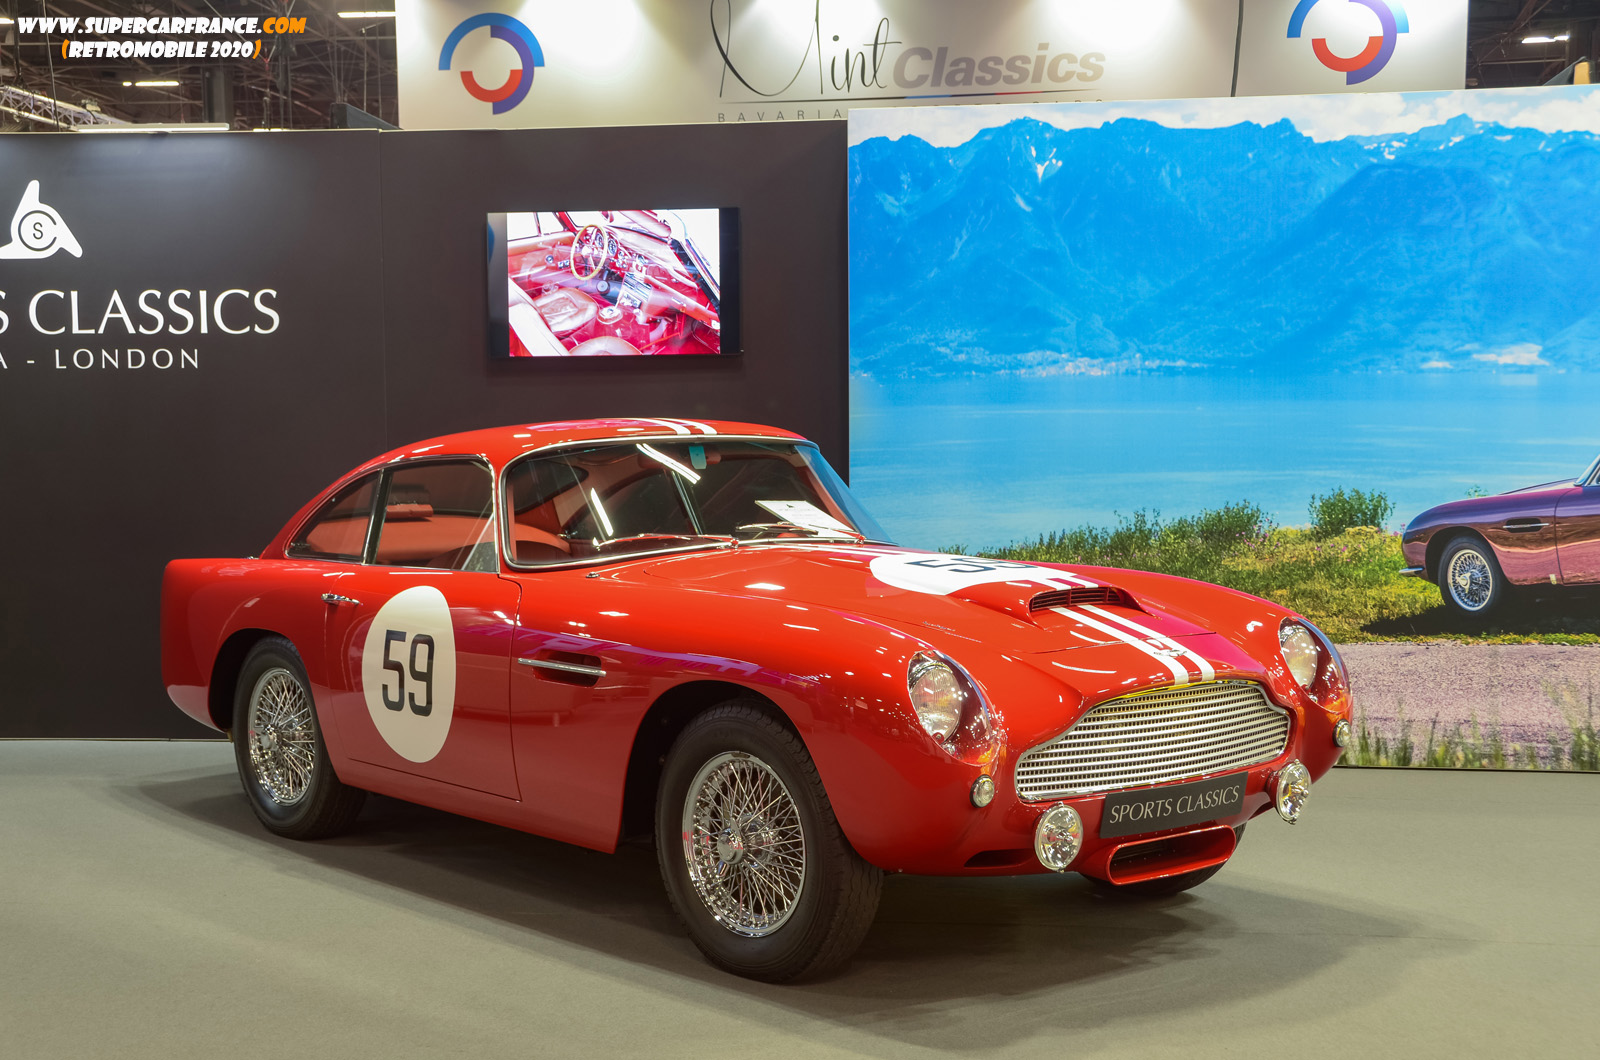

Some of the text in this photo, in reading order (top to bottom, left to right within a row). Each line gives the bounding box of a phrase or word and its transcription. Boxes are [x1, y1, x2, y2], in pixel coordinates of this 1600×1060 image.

[893, 42, 1106, 88] Classics
[29, 288, 280, 335] CLASSICS
[55, 348, 199, 369] LONDON
[904, 557, 1038, 573] 59
[382, 629, 434, 717] 59
[1109, 784, 1240, 824] SPORTS CLASSICS
